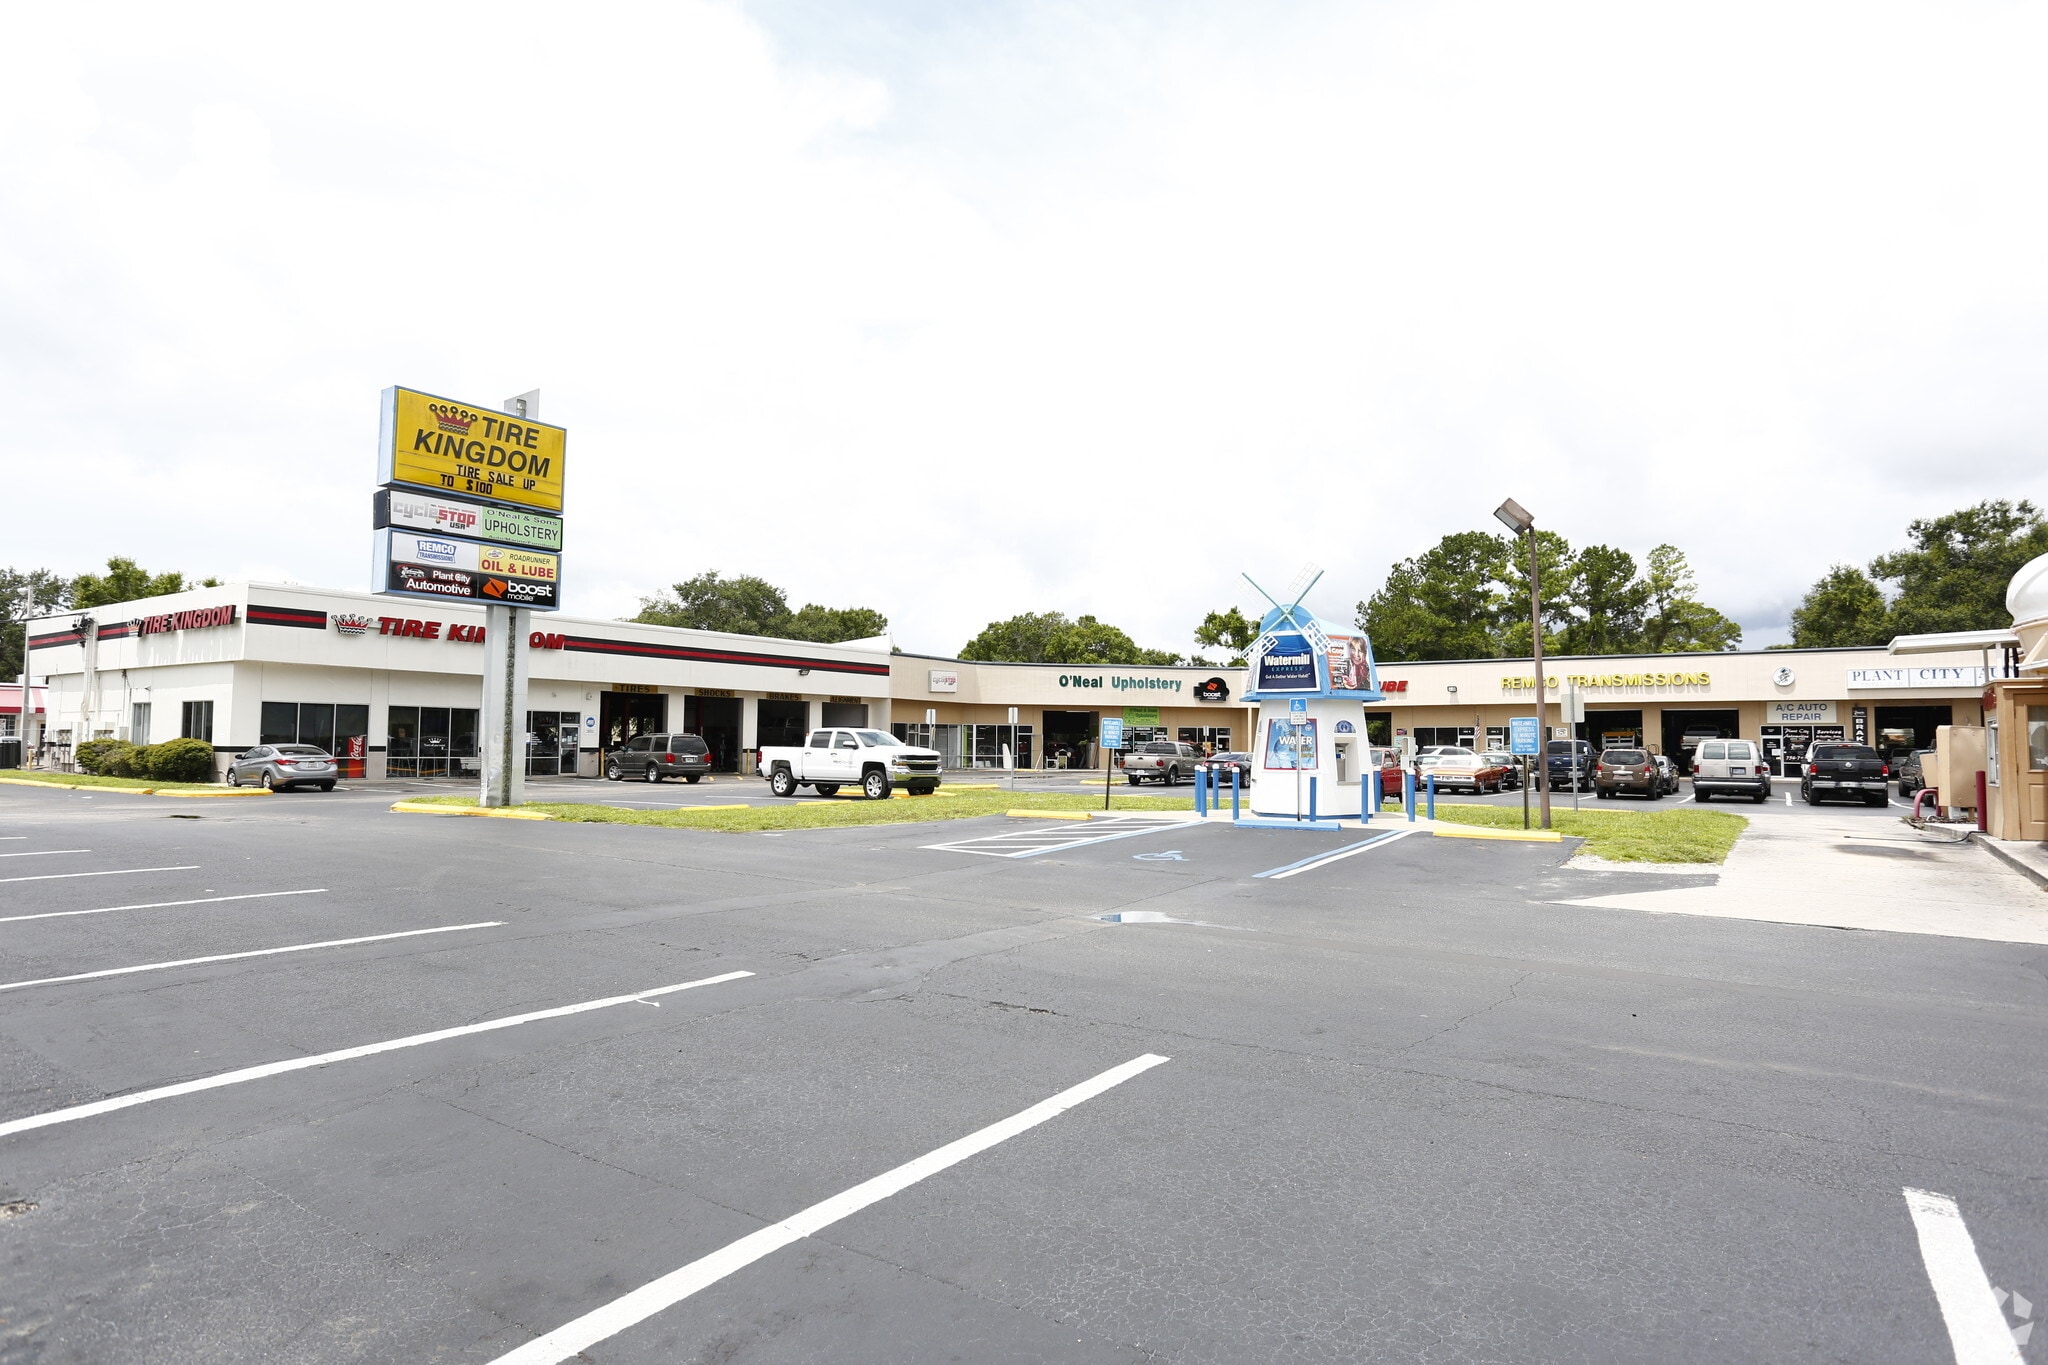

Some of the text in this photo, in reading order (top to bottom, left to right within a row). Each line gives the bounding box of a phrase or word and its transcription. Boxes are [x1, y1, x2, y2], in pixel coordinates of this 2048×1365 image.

[482, 416, 540, 450] TIRE
[413, 428, 551, 478] KINGDOM
[440, 474, 493, 495] TO $100
[456, 464, 536, 491] TIRE SALE UP
[449, 522, 466, 530] USA
[486, 509, 558, 527] O'Neal & Sons
[484, 518, 559, 542] UPHOLSTERY
[418, 541, 455, 555] REMCO
[418, 551, 455, 562] TRANSMISSIONS
[509, 553, 551, 565] ROADRUNNER
[432, 570, 471, 585] Plant City
[481, 559, 554, 579] OIL & LUBE
[406, 578, 471, 595] Automotive
[508, 580, 553, 597] boost
[507, 593, 534, 602] mobile
[142, 605, 237, 635] TIRE KINGDOM
[377, 616, 442, 640] TIRE
[1264, 652, 1310, 666] Watermill
[1059, 674, 1182, 692] O'Neal Upholstery
[1500, 672, 1711, 689] REMO TRANSMISSIONS
[1852, 669, 1903, 682] PLANT
[1919, 668, 1964, 680] CITY
[620, 684, 651, 693] TIRES
[698, 689, 732, 698] SHOCKS
[1775, 703, 1828, 711] A/C AUTO
[1781, 713, 1822, 721] REPAIR
[1855, 718, 1865, 743] BRAK
[1278, 736, 1313, 745] WAER
